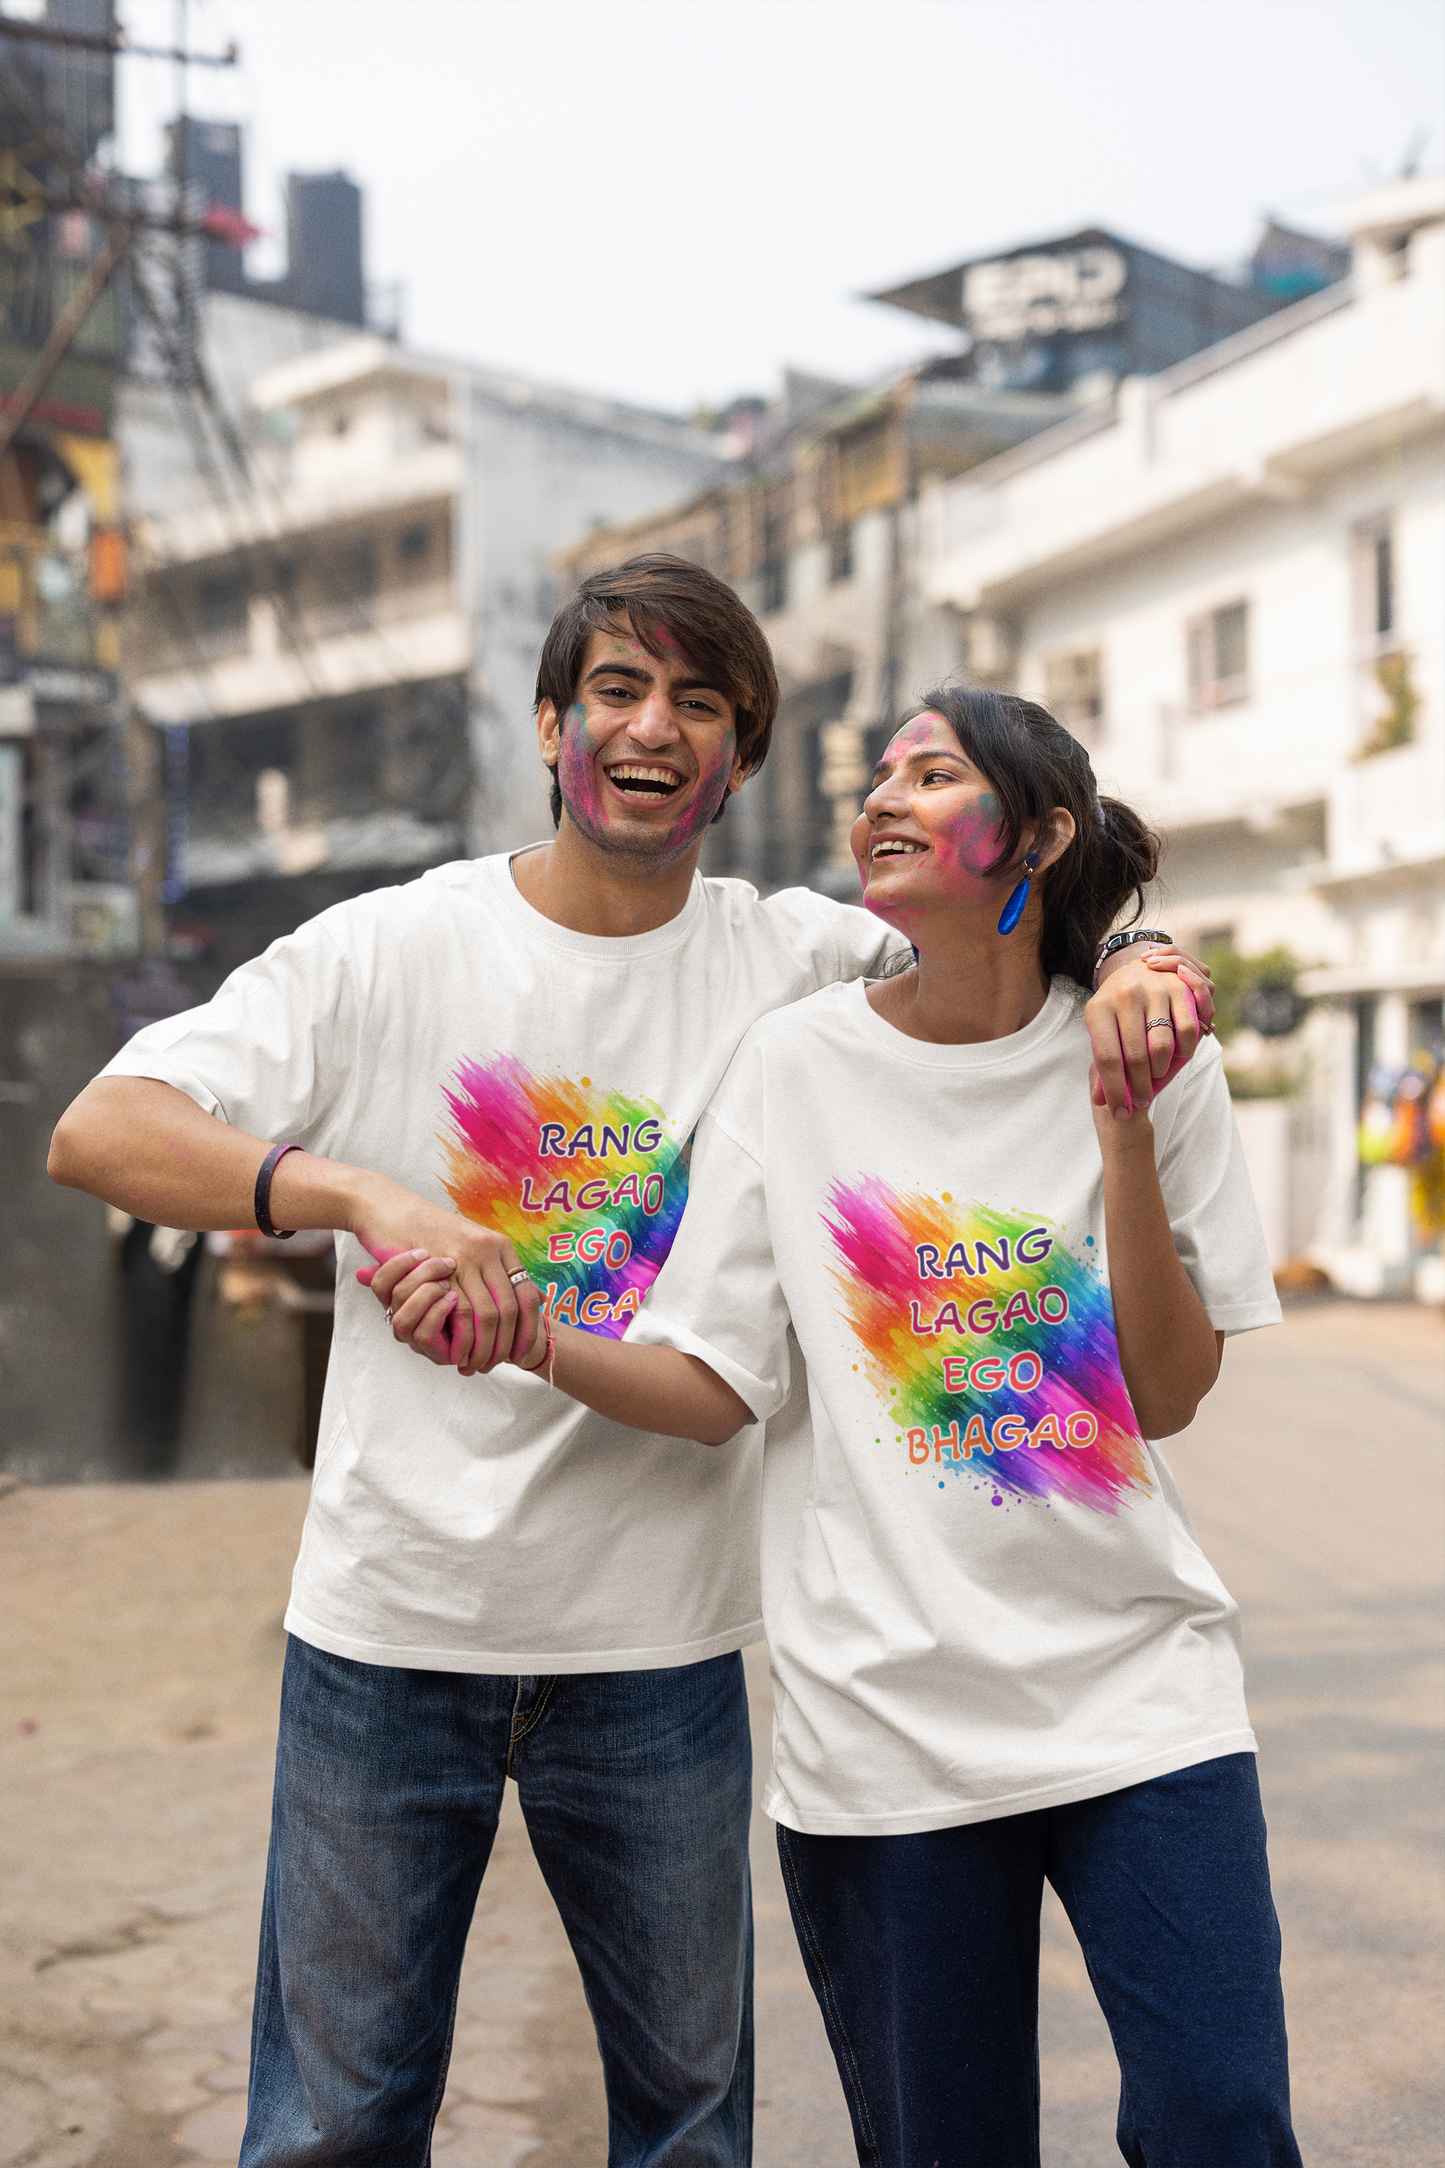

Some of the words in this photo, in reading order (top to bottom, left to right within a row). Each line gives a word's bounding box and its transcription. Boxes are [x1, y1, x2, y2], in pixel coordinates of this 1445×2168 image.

[539, 1119, 663, 1158] RANG
[521, 1173, 664, 1216] LAGAO
[547, 1228, 632, 1270] EGO
[915, 1227, 1053, 1279] RANG
[910, 1286, 1069, 1335] LAGAO
[942, 1351, 1044, 1394] EGO
[906, 1411, 1098, 1465] BHAGAO
